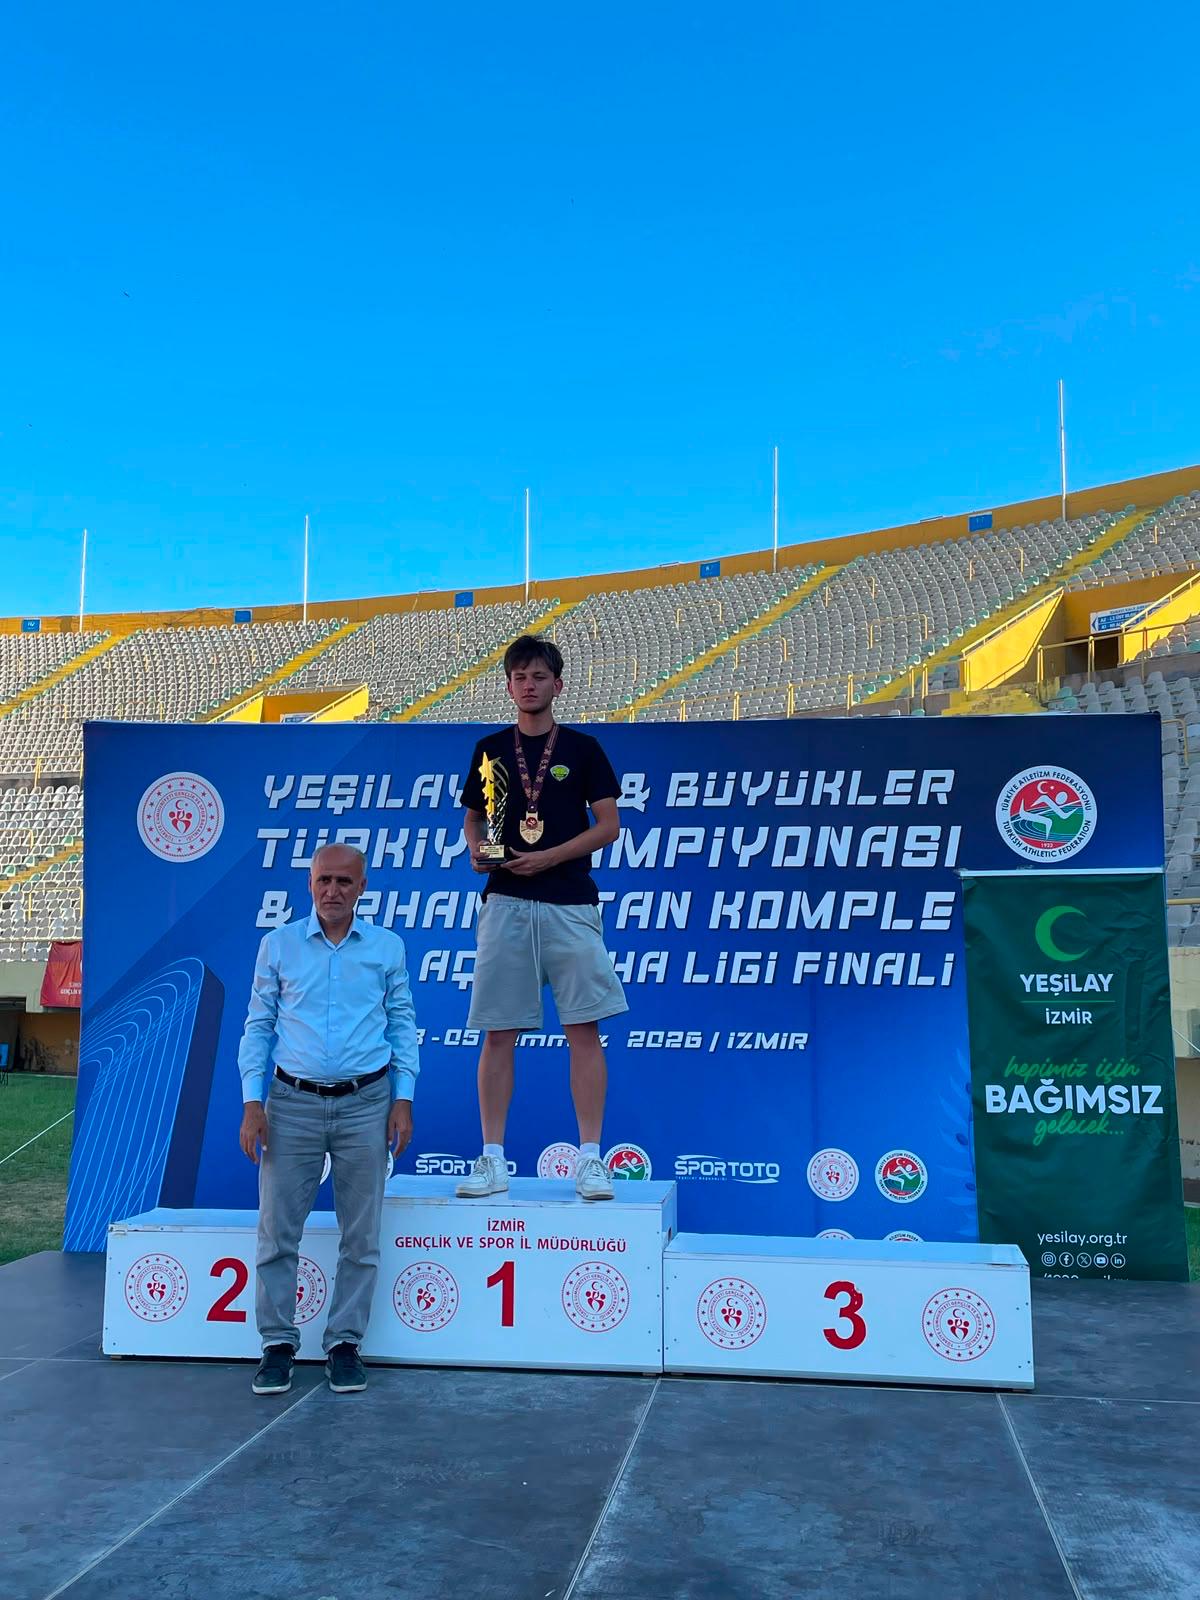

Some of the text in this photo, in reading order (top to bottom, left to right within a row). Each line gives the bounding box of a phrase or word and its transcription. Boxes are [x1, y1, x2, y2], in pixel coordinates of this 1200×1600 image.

[264, 769, 955, 814] YEŞİLAY & BÜYÜKLER
[1001, 771, 1092, 811] TÜRKİYE ATLETİZM FEDERASYONU
[257, 825, 962, 868] TÜRKİY MPİYONASI
[1003, 820, 1092, 858] TURKISH ATHLETIC FEDERATION
[256, 891, 293, 928] &
[709, 891, 955, 930] KOMPLE
[683, 951, 778, 985] LİGİ
[793, 952, 955, 986] FİNALİ
[1019, 973, 1114, 996] YEŞİLAY
[1045, 1008, 1093, 1025] İZMİR
[444, 1028, 481, 1046] 05
[626, 1030, 703, 1049] 2026
[709, 1031, 720, 1053] /
[727, 1032, 809, 1051] İZMİR
[1004, 1056, 1141, 1083] hepimiz için
[985, 1078, 1164, 1114] BAĞIMSIZ
[415, 1159, 517, 1176] SPORTO
[674, 1160, 780, 1178] SPORTOTO
[487, 1217, 525, 1232] İZMİR
[1037, 1230, 1128, 1247] yesilay.org.tr
[395, 1234, 627, 1252] GENÇLİK VE SPOR İL MÜDÜRLÜĞÜ
[206, 1257, 249, 1323] 2
[486, 1260, 515, 1328] 1
[823, 1280, 867, 1350] 3
